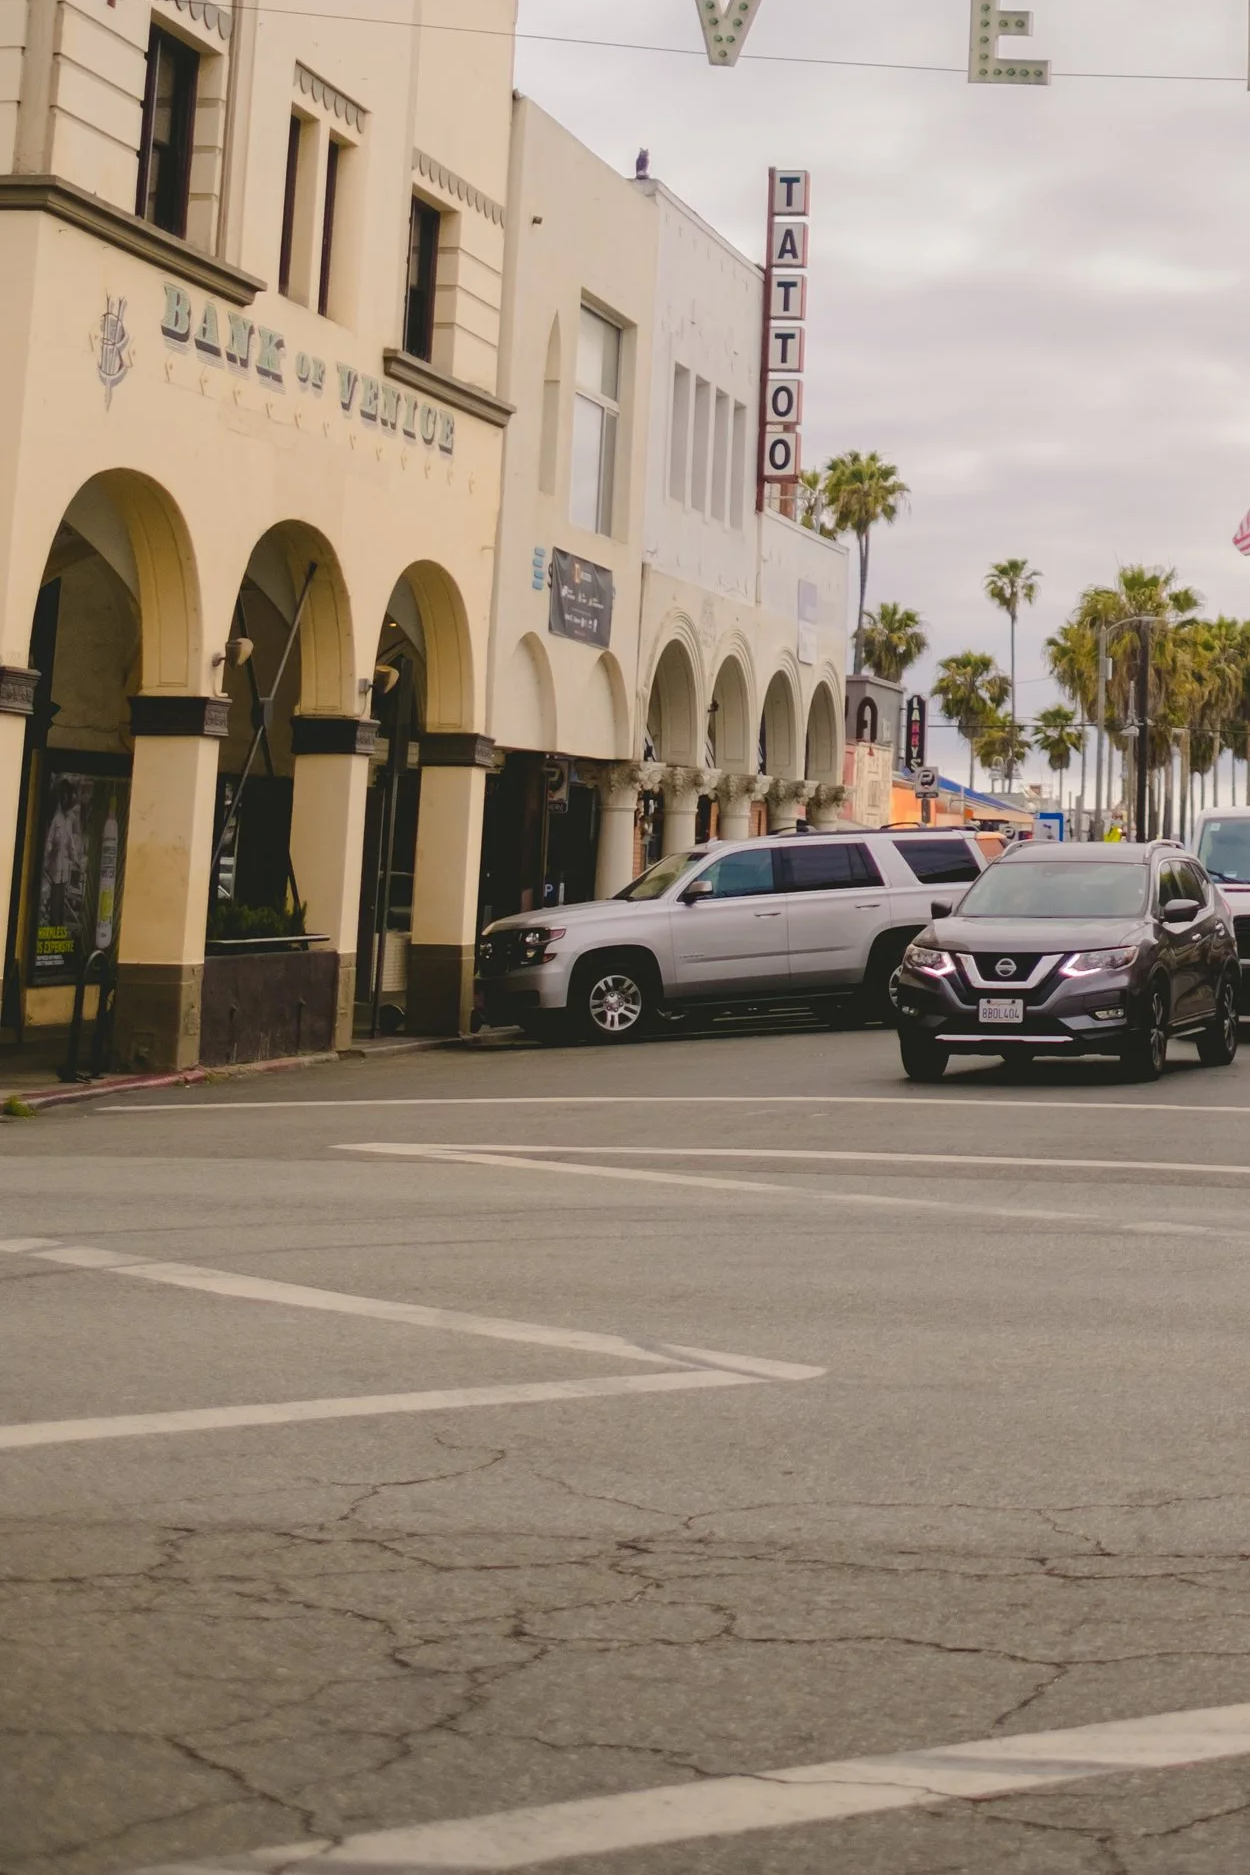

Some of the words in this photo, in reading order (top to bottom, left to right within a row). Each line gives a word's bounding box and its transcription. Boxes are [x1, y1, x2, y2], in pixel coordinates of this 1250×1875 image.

[160, 281, 286, 387] BANK
[295, 351, 326, 390] OF
[336, 361, 455, 456] VENICE
[769, 176, 801, 471] TATTOO
[544, 884, 553, 897] P
